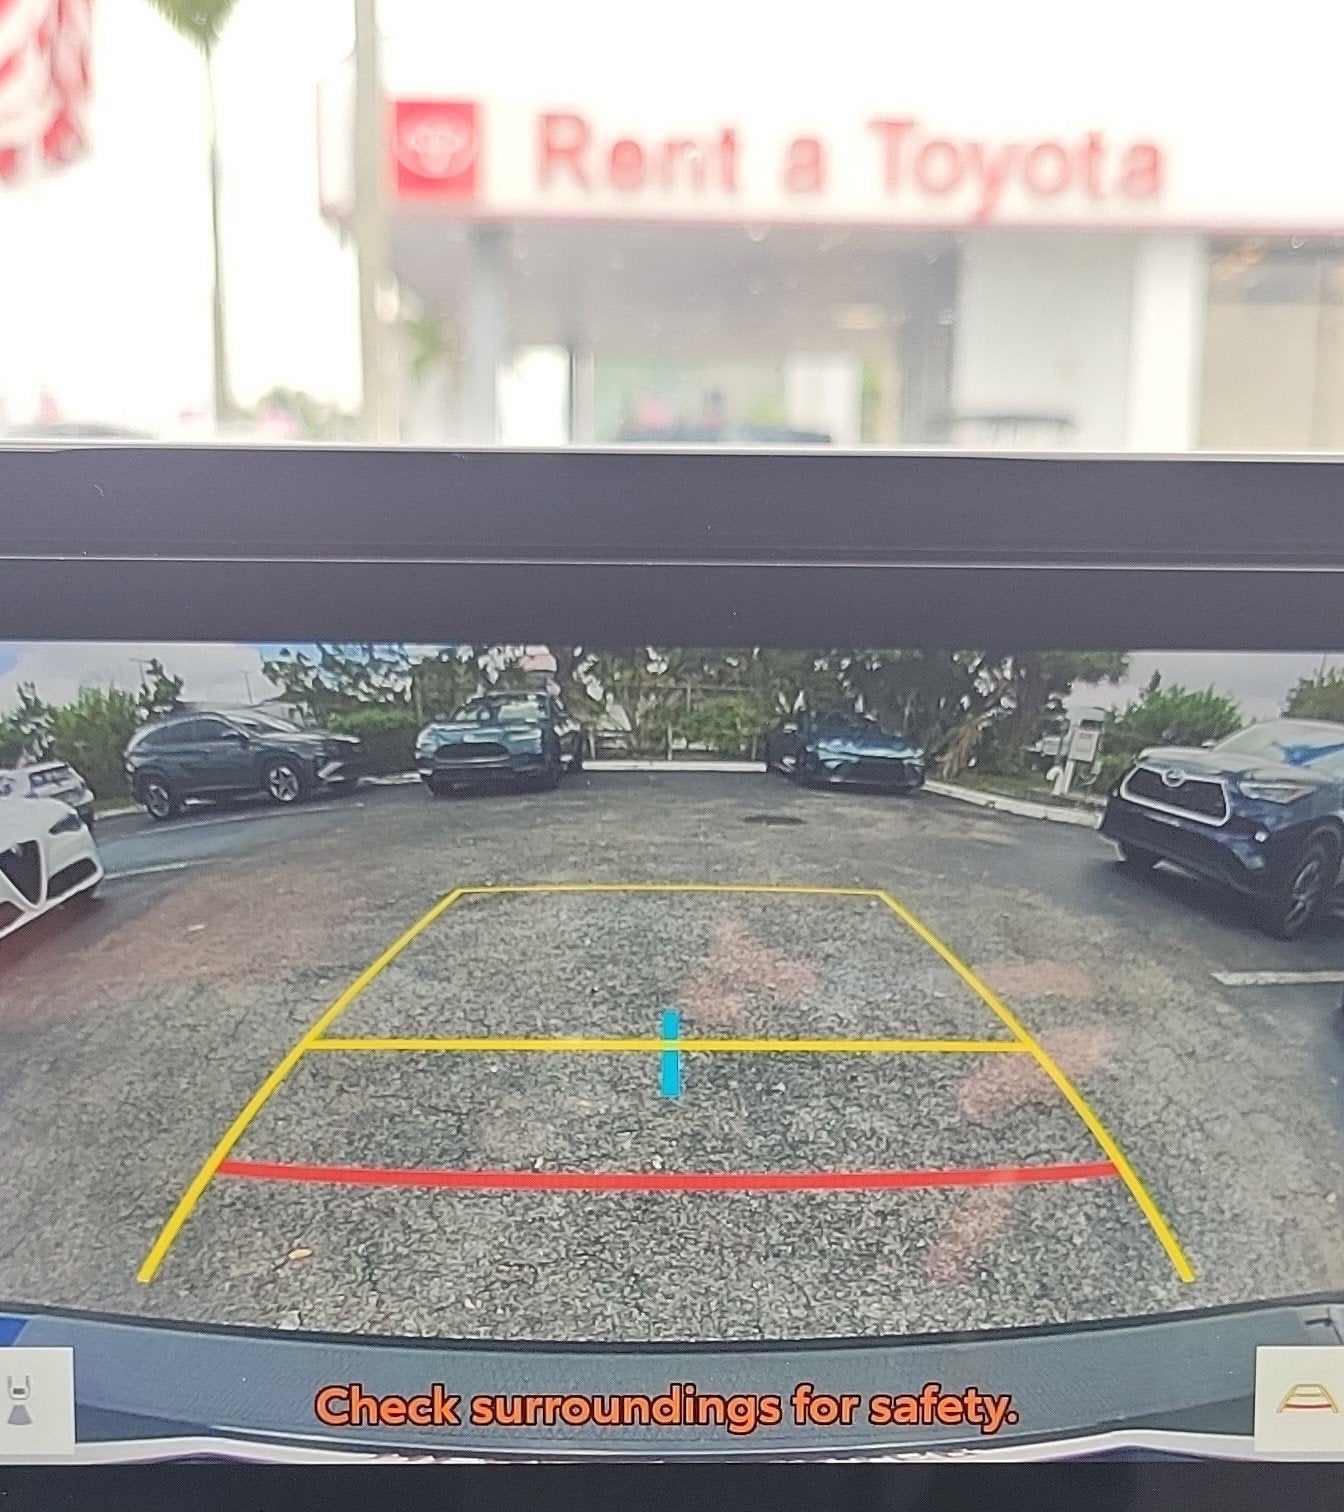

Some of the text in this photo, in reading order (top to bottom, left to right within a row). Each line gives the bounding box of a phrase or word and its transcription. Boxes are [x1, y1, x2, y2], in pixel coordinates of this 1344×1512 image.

[535, 112, 1167, 225] Rent a Toyota
[314, 1384, 1020, 1435] Check surroundings for safety.
